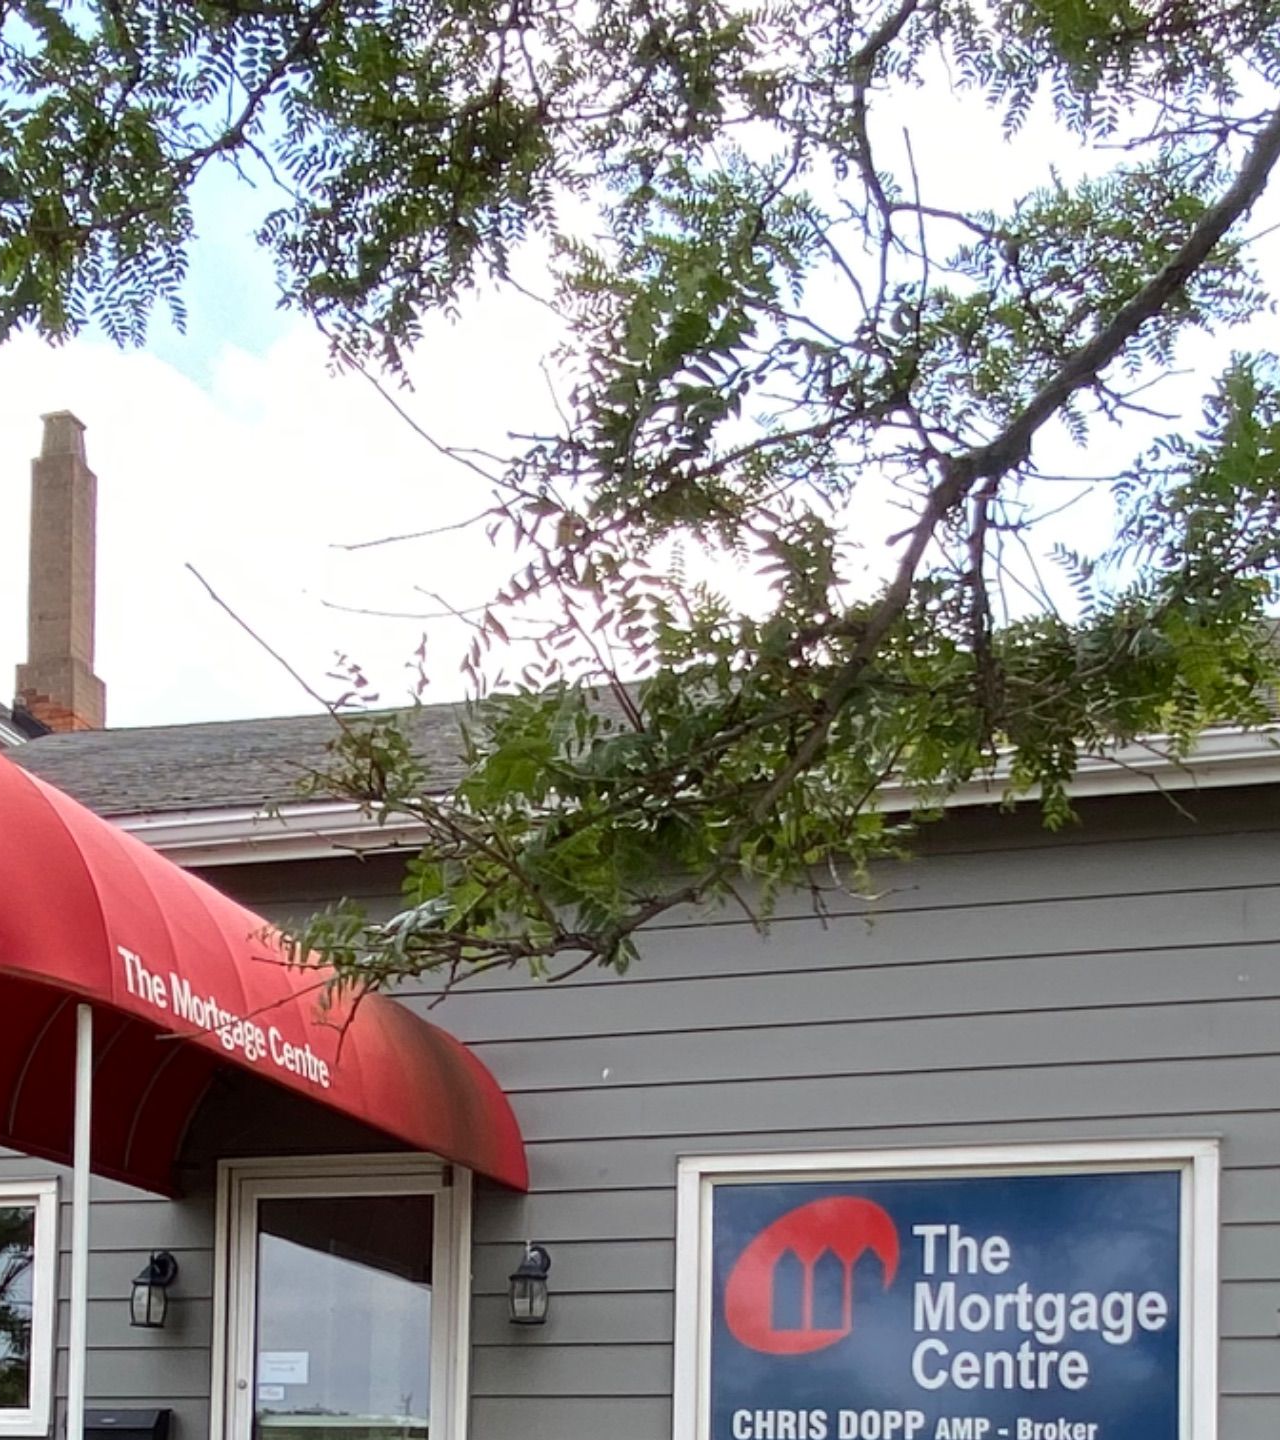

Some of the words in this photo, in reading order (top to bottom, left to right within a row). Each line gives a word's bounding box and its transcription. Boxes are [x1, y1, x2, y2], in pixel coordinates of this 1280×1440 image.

[117, 945, 168, 1008] The
[169, 972, 267, 1062] Mortgage
[268, 1026, 330, 1089] Centre
[912, 1224, 1011, 1275] The
[912, 1282, 1168, 1345] Mortgage
[911, 1338, 1090, 1391] Centre
[732, 1409, 828, 1440] CHRIS
